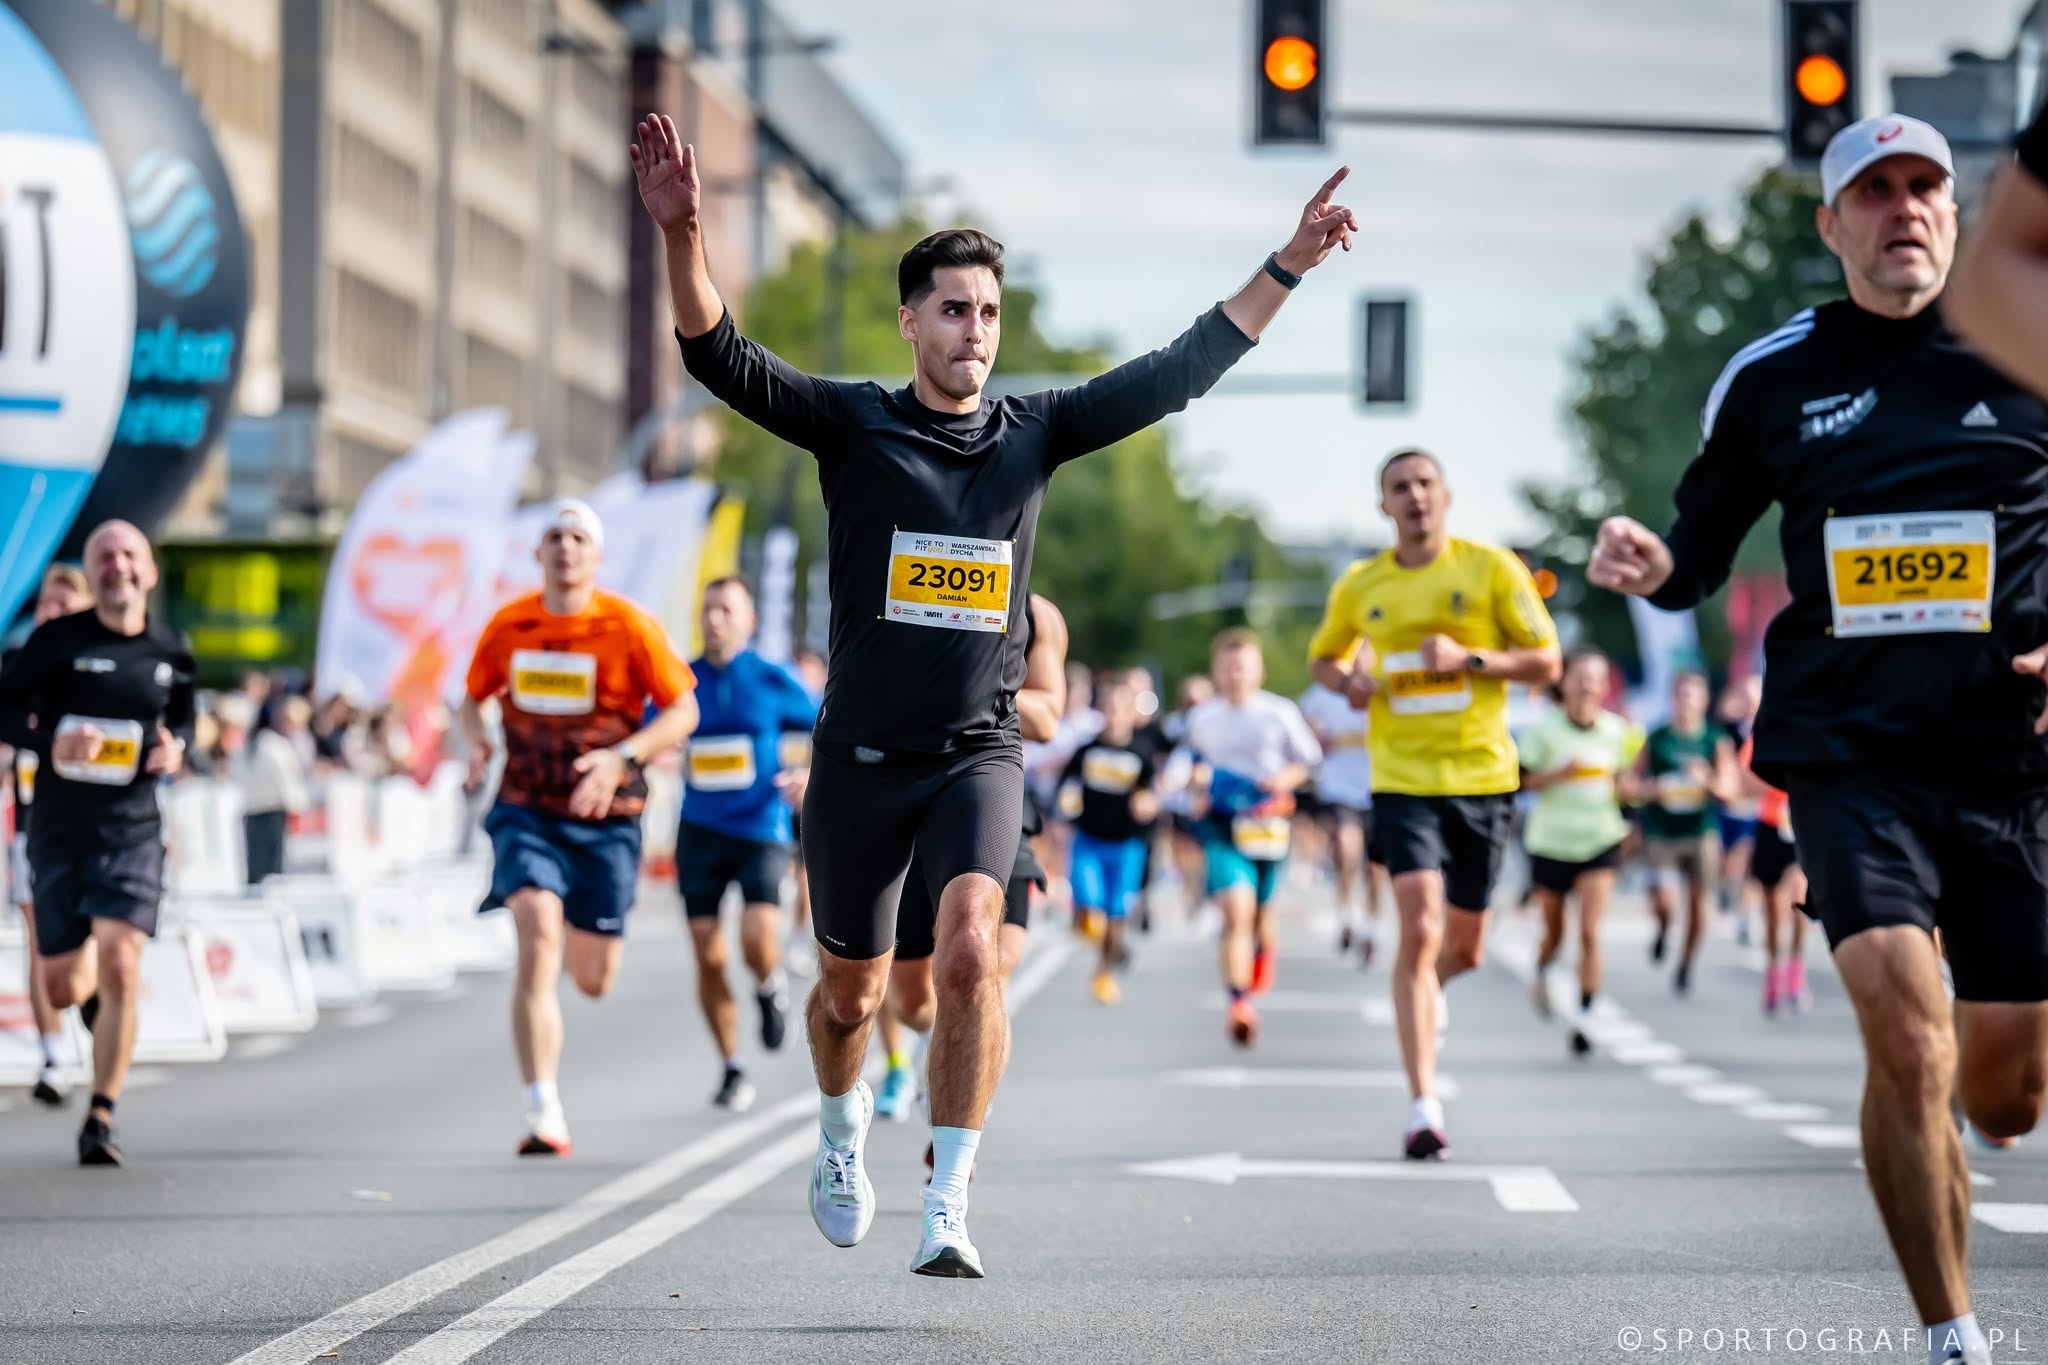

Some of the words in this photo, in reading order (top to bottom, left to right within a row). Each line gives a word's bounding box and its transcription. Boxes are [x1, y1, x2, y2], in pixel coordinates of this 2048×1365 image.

[915, 539, 933, 547] NICE
[934, 540, 944, 548] TO
[951, 542, 996, 553] WARSZAWSKA
[950, 548, 974, 557] DYCHA
[1853, 551, 1969, 586] 21692
[908, 563, 996, 593] 23091
